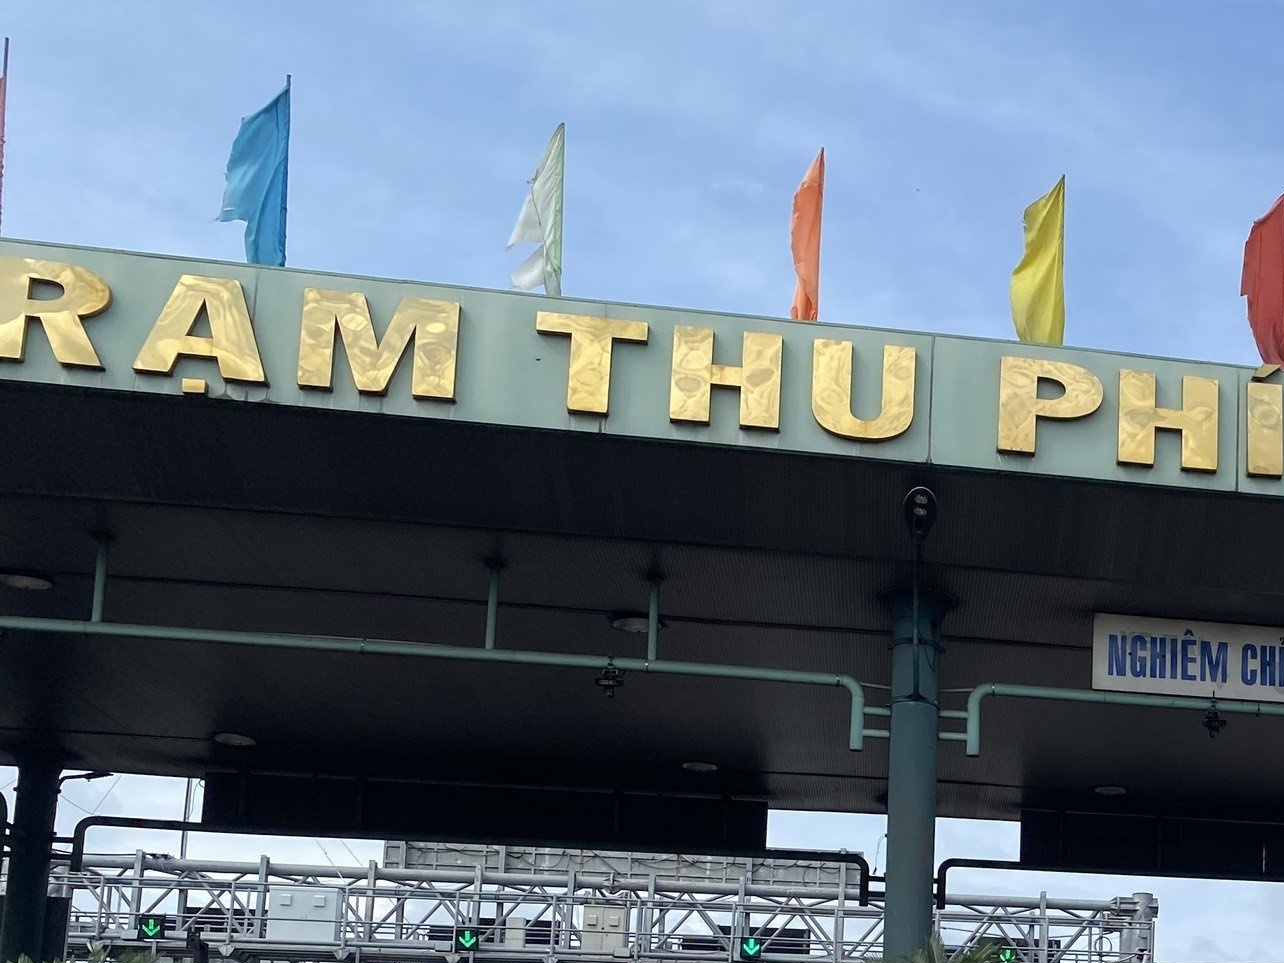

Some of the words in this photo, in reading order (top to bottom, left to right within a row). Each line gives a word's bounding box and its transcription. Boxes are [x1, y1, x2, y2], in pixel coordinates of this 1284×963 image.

[536, 310, 916, 442] THU
[996, 356, 1284, 480] PHÍ
[1107, 628, 1229, 684] NGHIÊM
